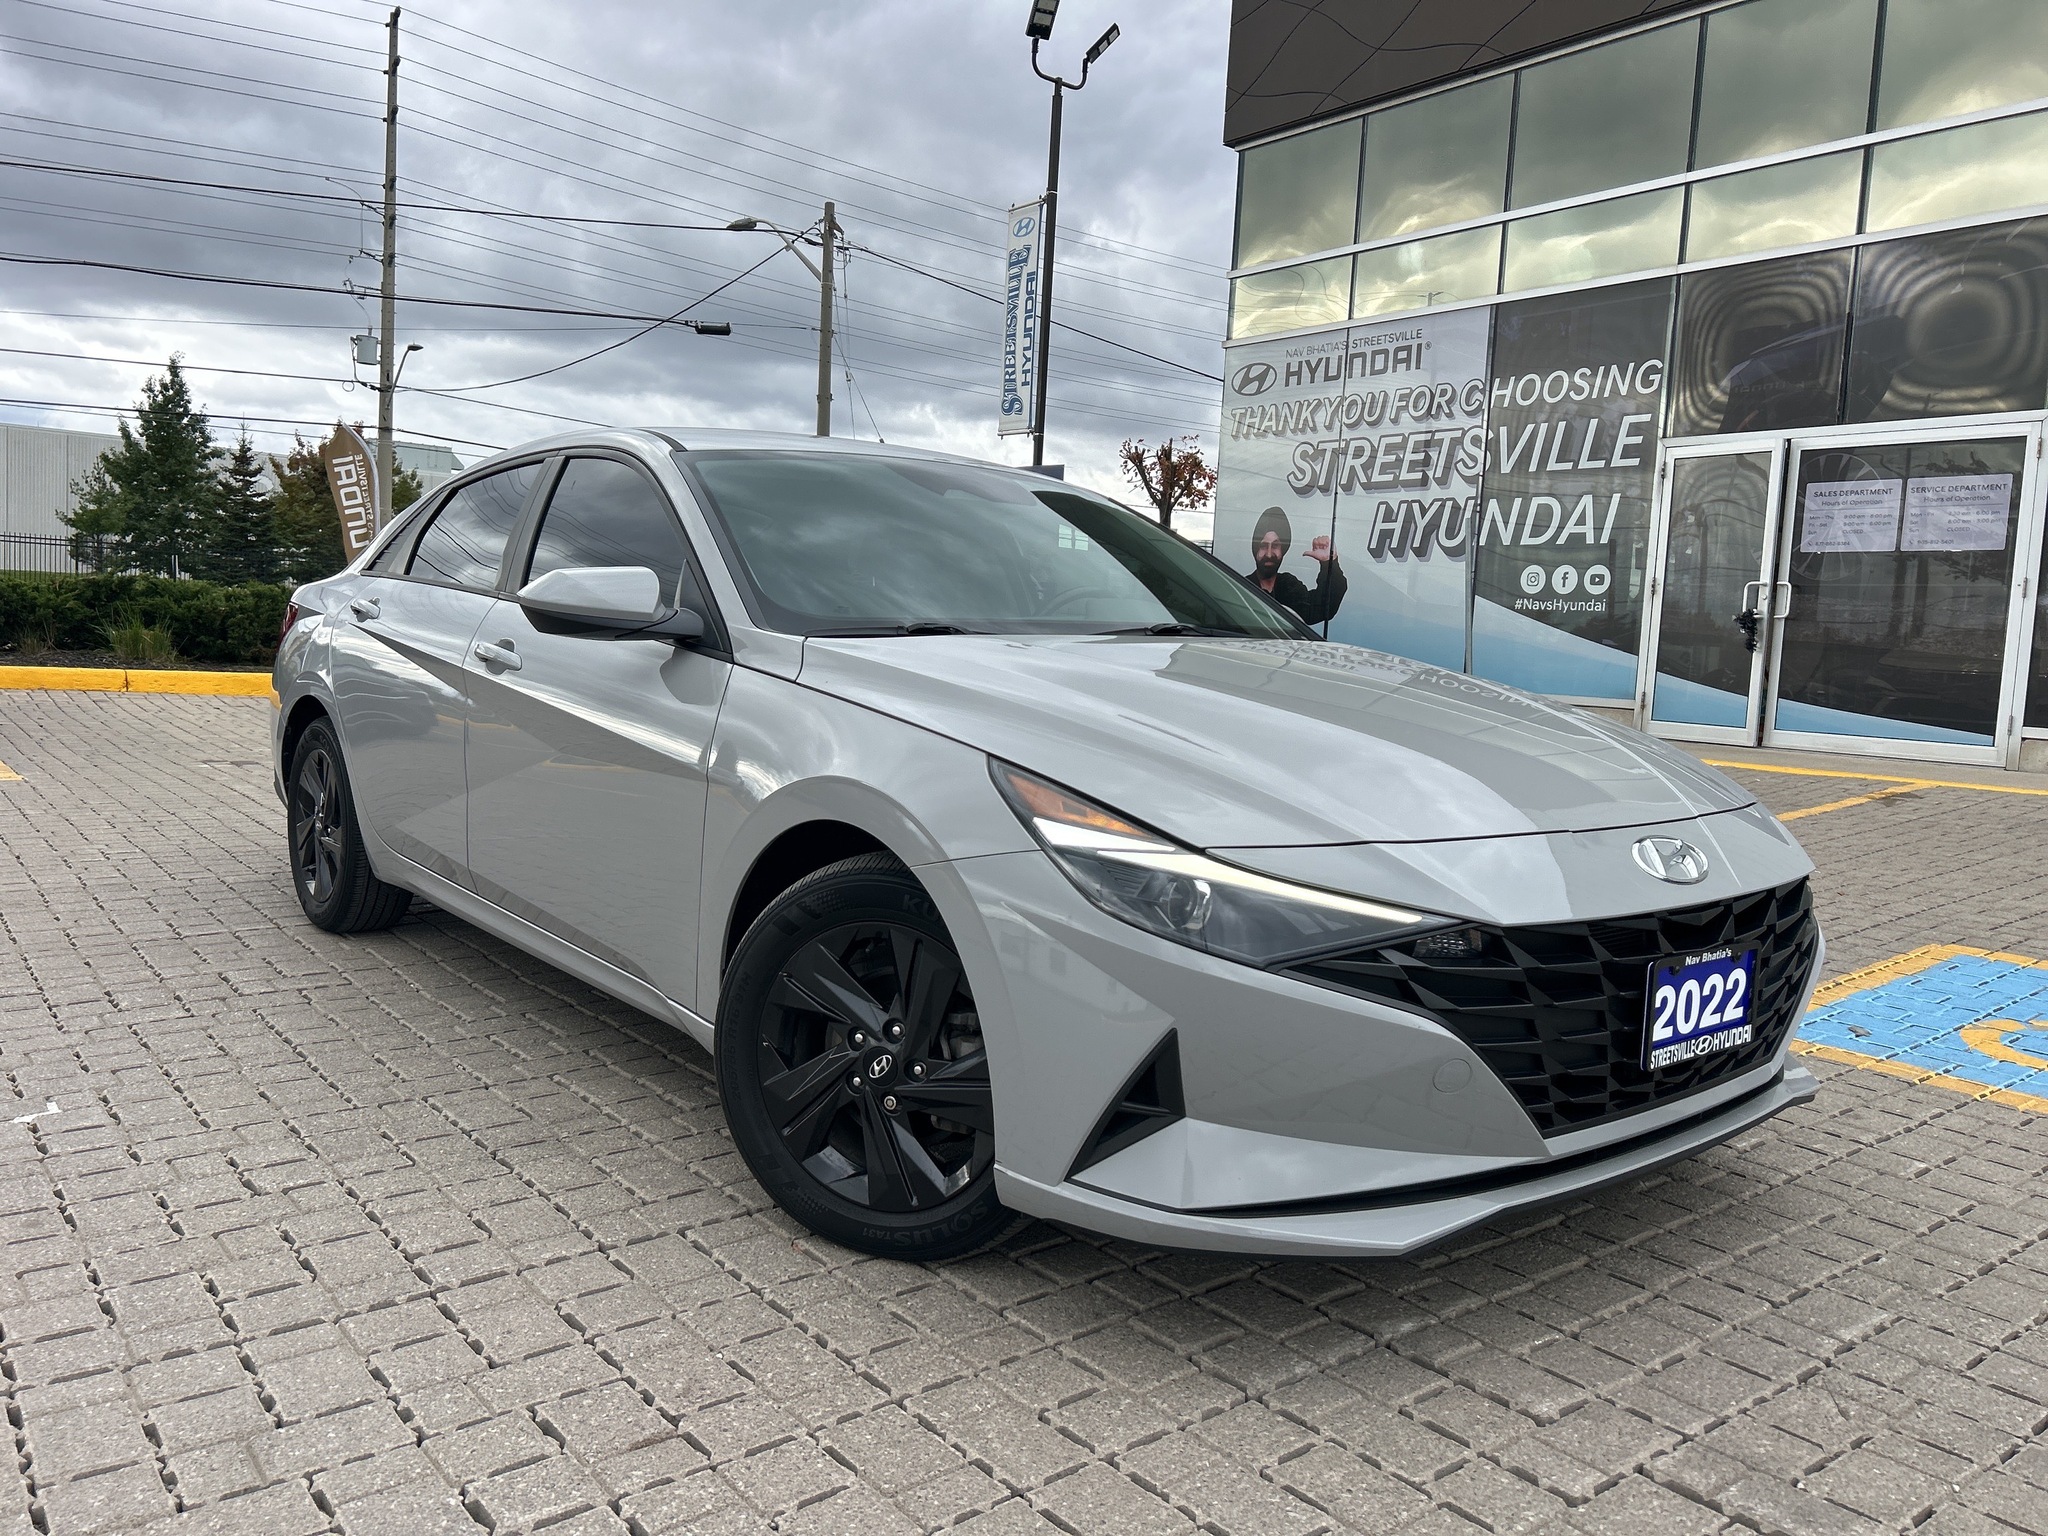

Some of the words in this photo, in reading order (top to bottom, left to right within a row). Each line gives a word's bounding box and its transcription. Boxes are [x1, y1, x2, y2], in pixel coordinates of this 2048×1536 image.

[1001, 244, 1032, 416] STREETSVILLE
[1021, 270, 1036, 386] HYUNDAI
[1285, 347, 1304, 358] NAV
[1306, 340, 1347, 356] BHATIA'S
[1352, 329, 1422, 349] STREETSVILLE
[1284, 342, 1423, 388] HYUNDAI
[1231, 399, 1321, 440] THANK
[1323, 391, 1389, 429] YOU
[1390, 383, 1457, 421] FOR
[1460, 358, 1663, 415] CHOOSING
[1287, 413, 1652, 497] STREETSVILLE
[1814, 490, 1838, 498] SALES
[1839, 488, 1894, 497] DEPARTMENT
[1910, 486, 1947, 494] SERVICE
[1948, 484, 2008, 492] DEPARTMENT
[1368, 493, 1622, 560] HYUNDAI
[1514, 598, 1606, 614] #NavsHyundai
[1685, 956, 1700, 966] Nav
[1702, 948, 1732, 962] Bhatia's
[1652, 968, 1746, 1042] 2022
[1650, 1040, 1696, 1069] STREETSVILLE
[1713, 1024, 1752, 1051] HYUNDAI
